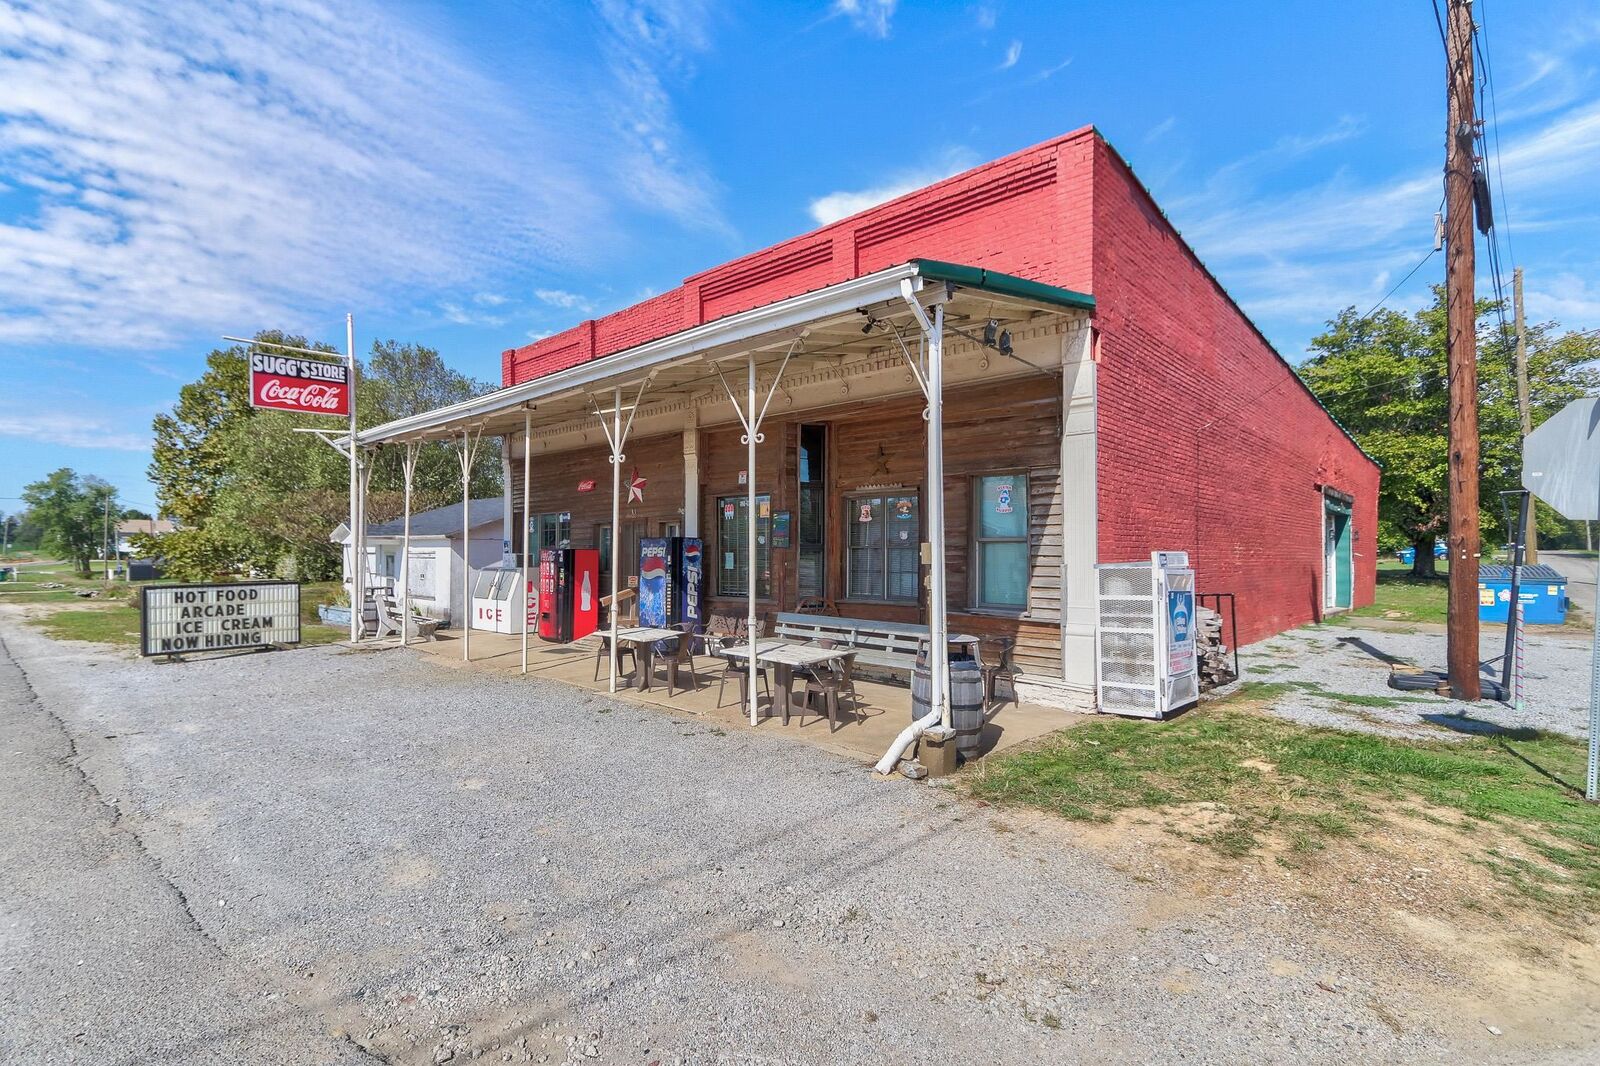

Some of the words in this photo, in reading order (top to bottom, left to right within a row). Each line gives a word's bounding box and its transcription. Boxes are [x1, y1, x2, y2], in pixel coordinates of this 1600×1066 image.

[253, 354, 310, 378] SUGG'S
[311, 365, 346, 380] STORE
[260, 379, 341, 409] Coca-Cola
[641, 547, 666, 557] PEPSI
[174, 590, 207, 604] HOT
[216, 589, 258, 602] FOOD
[687, 566, 698, 618] PEPSI
[181, 604, 245, 619] ARCADE
[479, 607, 503, 623] ICE
[176, 621, 203, 634] ICE
[221, 617, 273, 631] CREAM
[162, 636, 199, 651] NOW
[205, 632, 261, 648] HIRING
